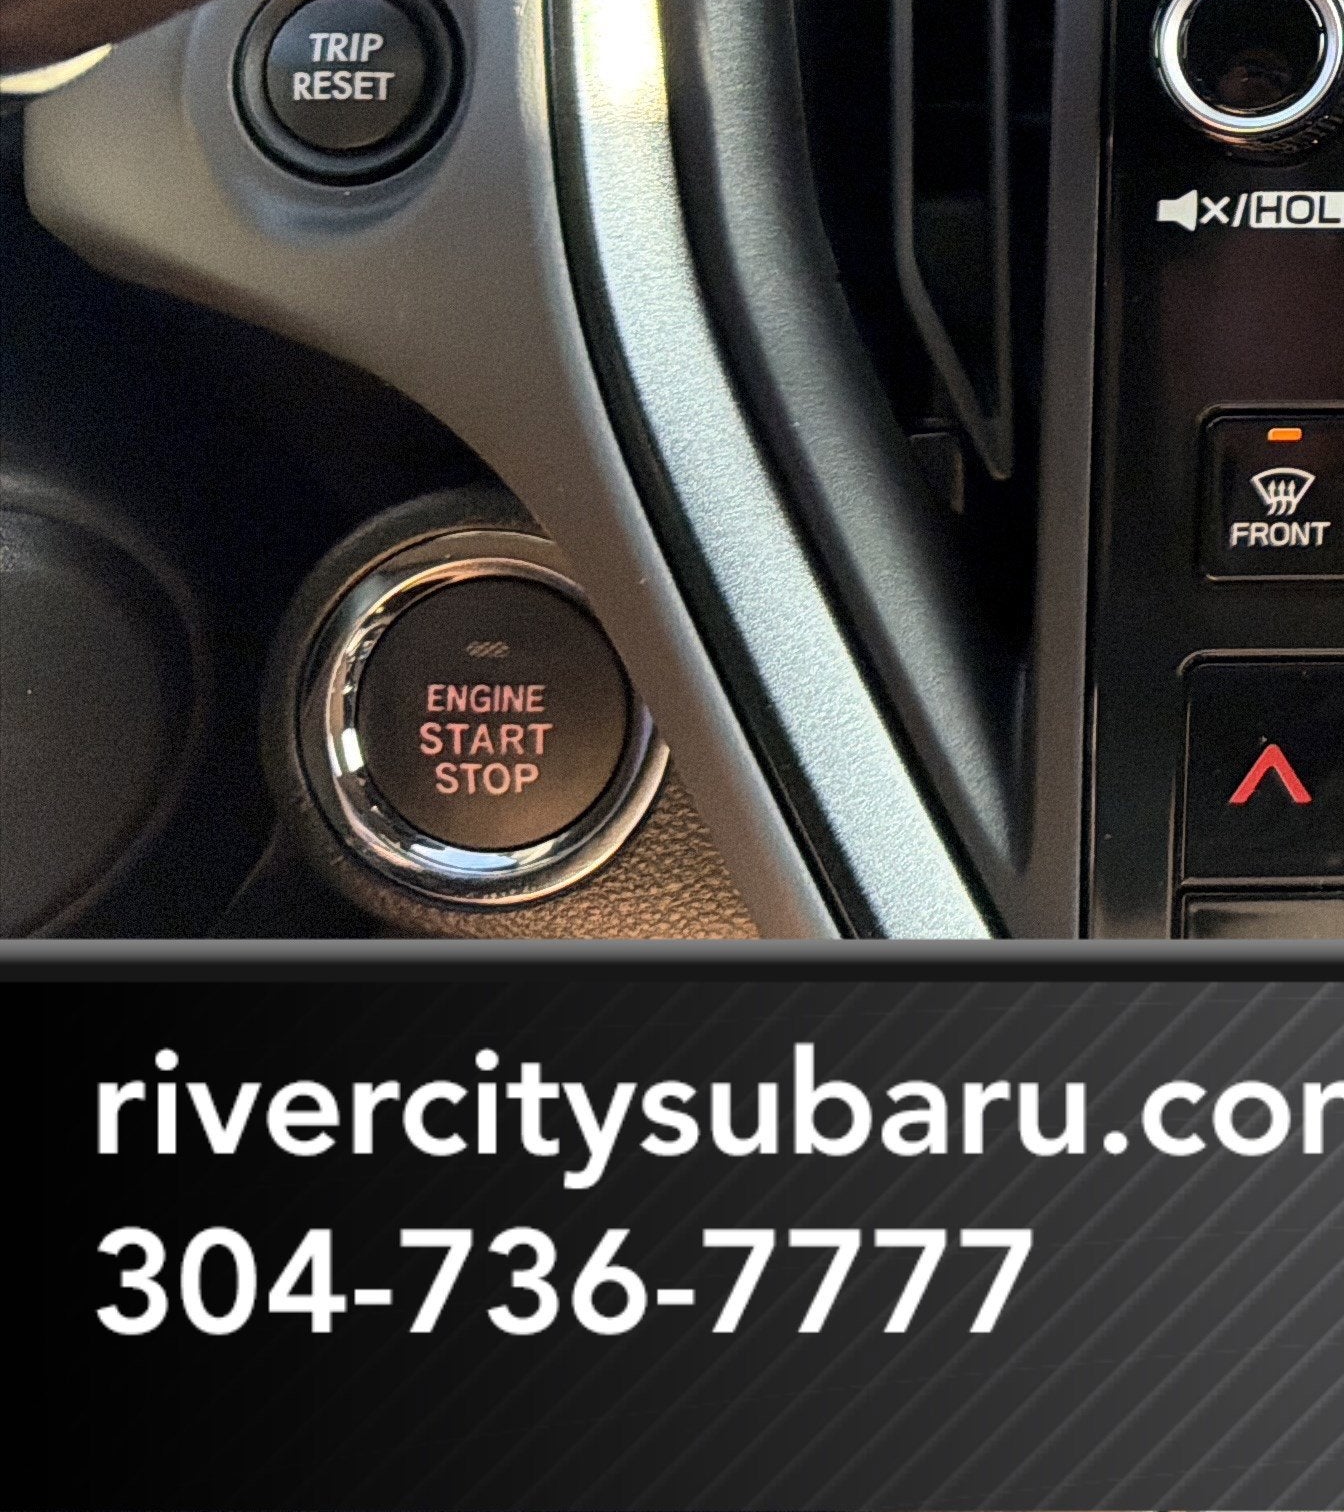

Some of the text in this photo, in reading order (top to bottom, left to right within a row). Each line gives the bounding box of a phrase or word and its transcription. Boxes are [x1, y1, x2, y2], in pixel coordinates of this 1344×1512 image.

[308, 32, 385, 64] TRIP
[292, 69, 396, 103] RESET
[1228, 520, 1332, 548] FRONT
[426, 683, 547, 714] ENGINE
[419, 722, 554, 756] START
[434, 762, 541, 796] STOP
